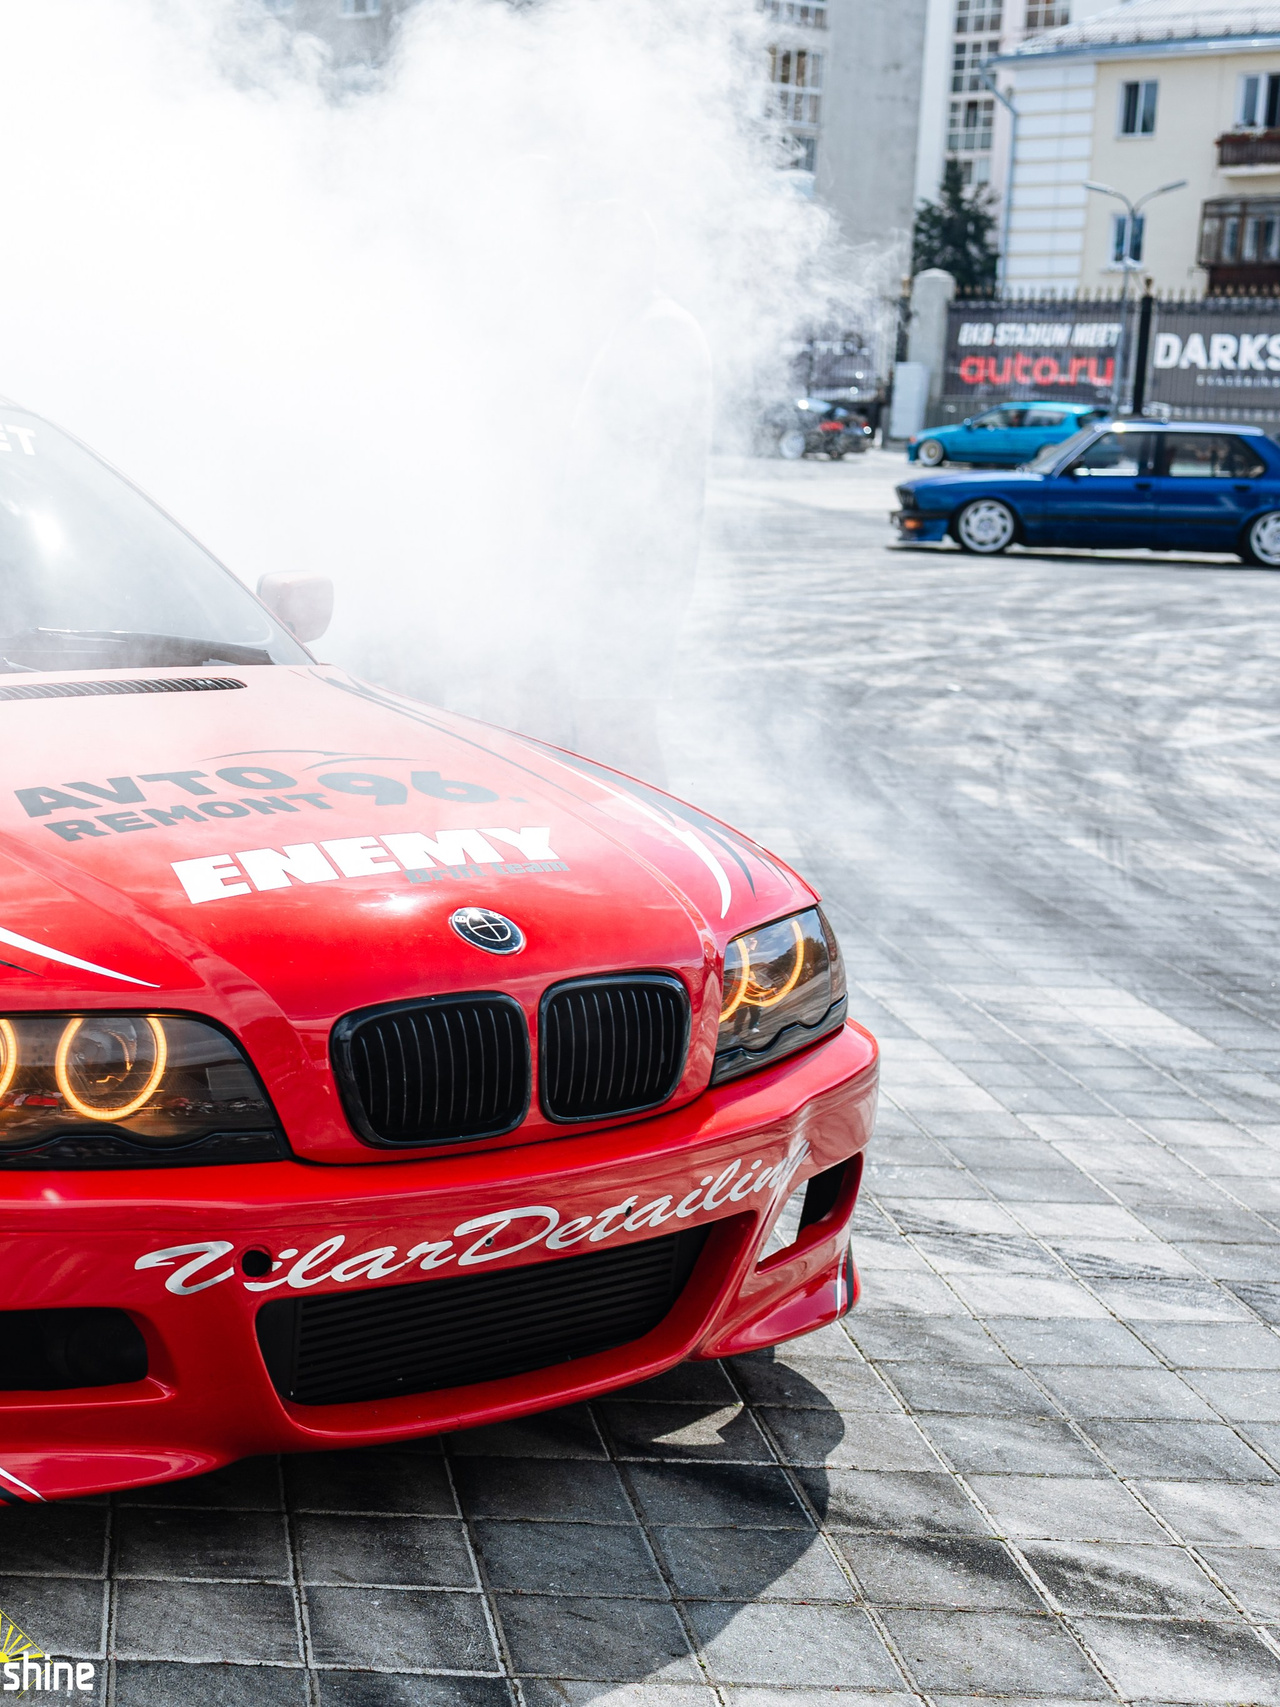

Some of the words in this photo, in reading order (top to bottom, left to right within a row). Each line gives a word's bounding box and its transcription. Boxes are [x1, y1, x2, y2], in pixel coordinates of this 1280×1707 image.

[1072, 322, 1122, 347] MEET
[959, 351, 1116, 386] auto.ru
[13, 766, 299, 818] AVTO
[43, 792, 335, 842] REMONT
[170, 826, 560, 905] ENEMY
[490, 861, 571, 875] team
